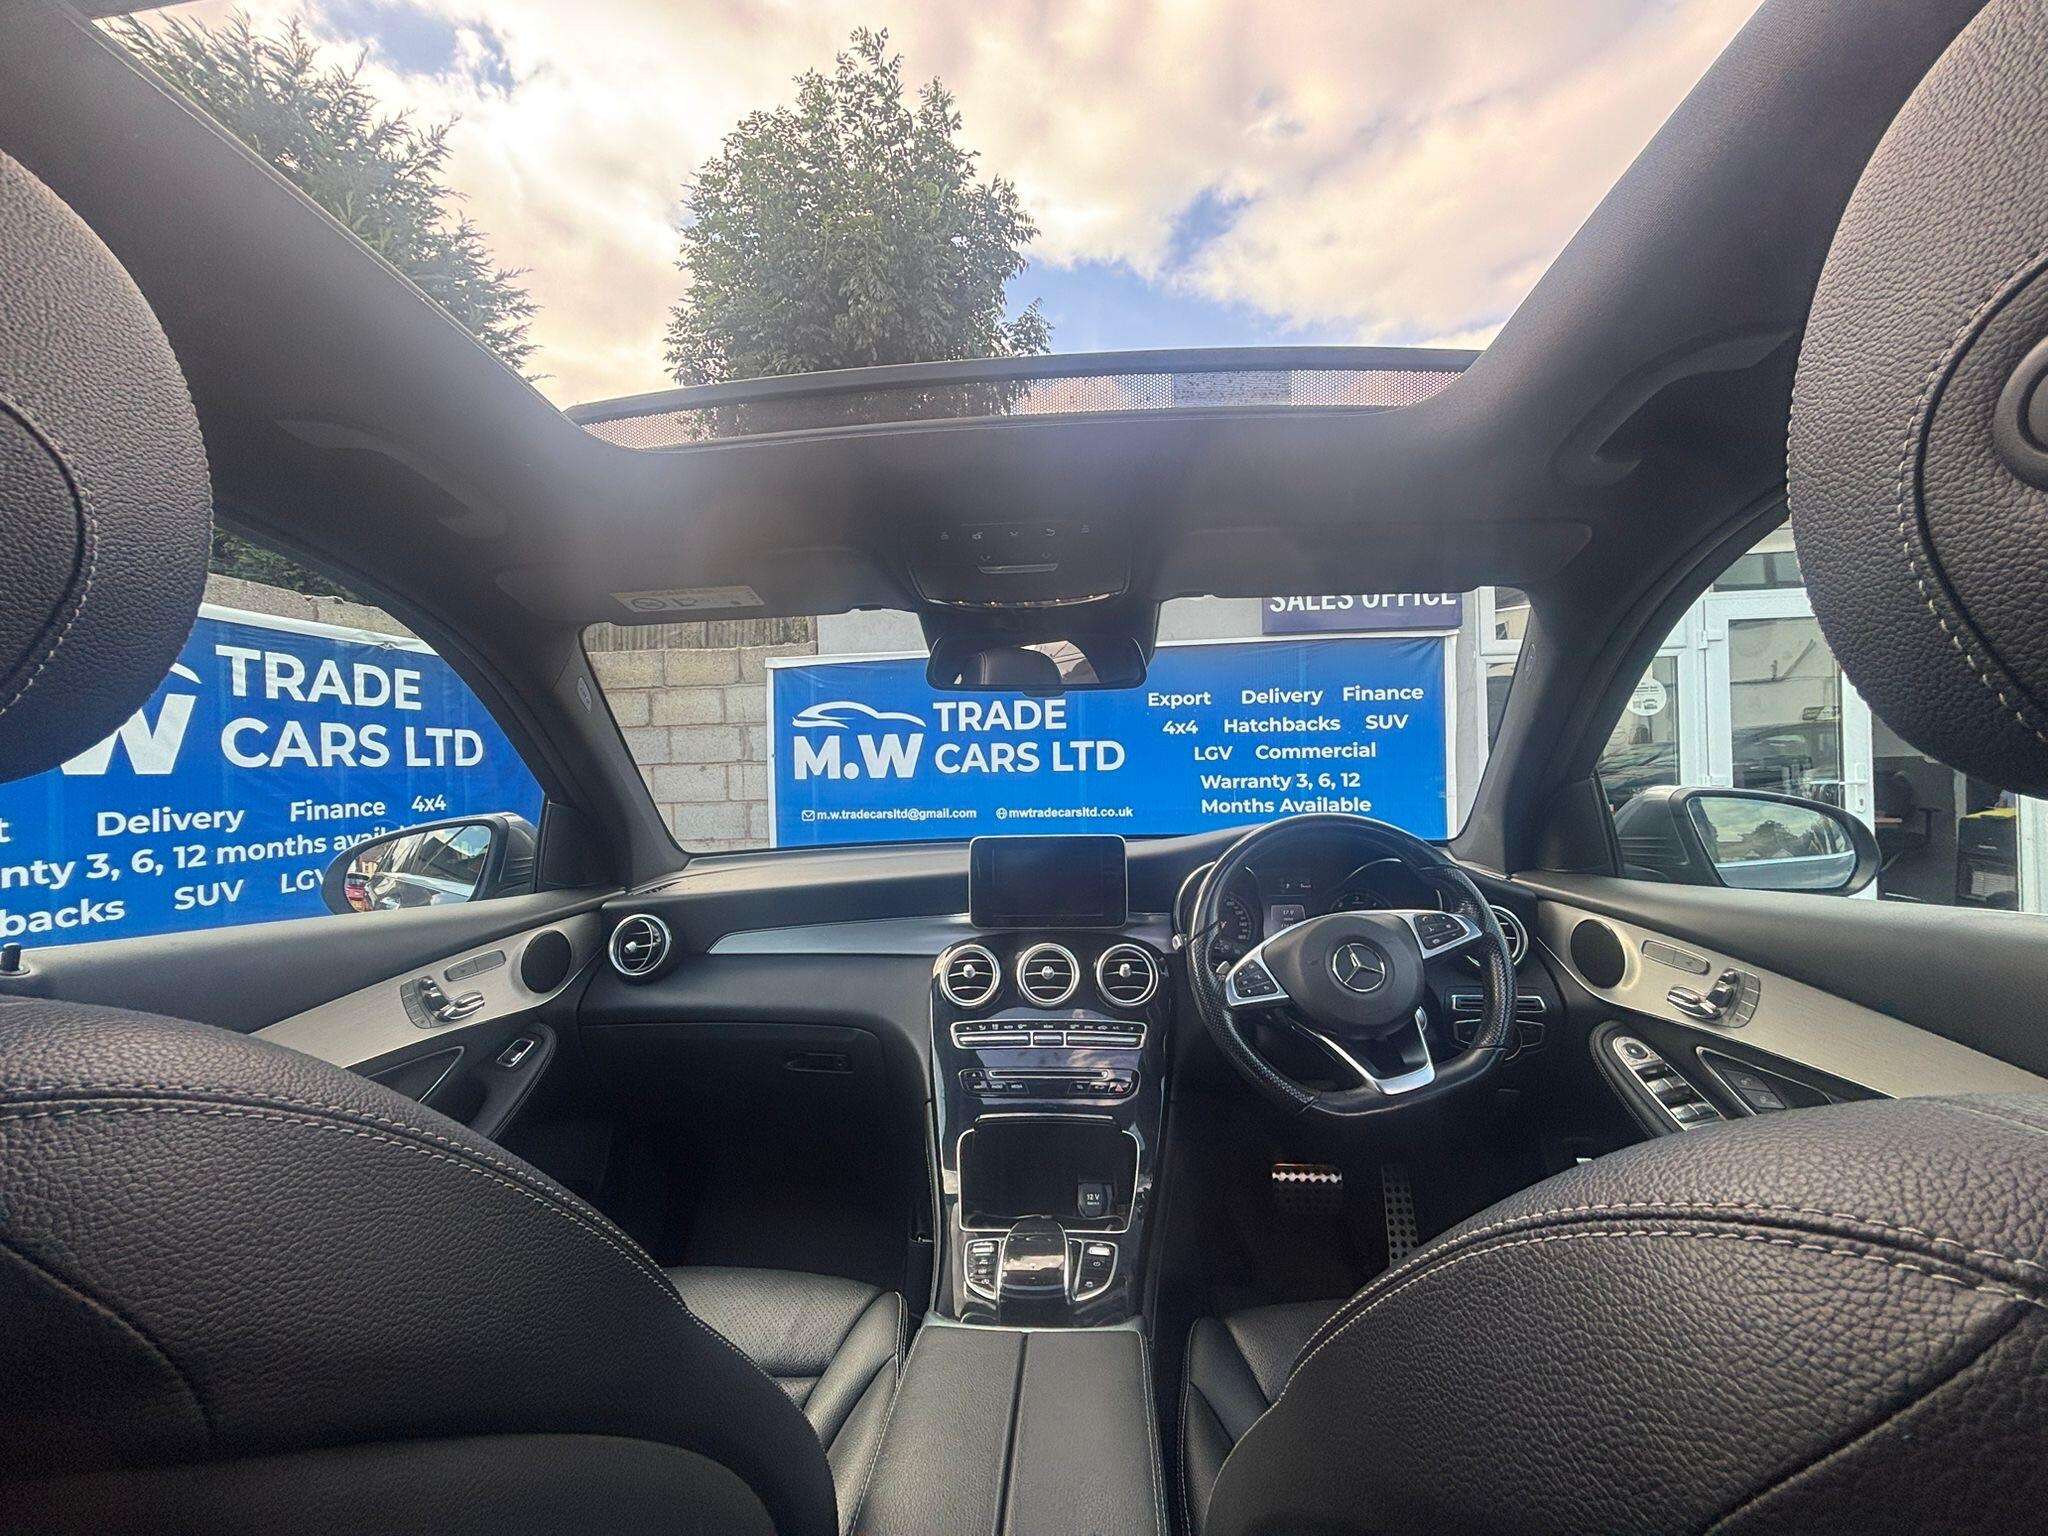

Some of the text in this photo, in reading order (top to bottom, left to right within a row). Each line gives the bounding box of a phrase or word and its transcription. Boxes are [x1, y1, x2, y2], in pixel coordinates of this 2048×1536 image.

[1269, 592, 1456, 612] SALES OFFICE
[215, 645, 422, 711] TRADE
[1149, 684, 1424, 709] Export Delivery Finance
[932, 699, 1067, 732] TRADE
[1162, 714, 1409, 735] 4x4 Hatchbacks SUV
[220, 717, 484, 768] CARS LTD
[793, 733, 924, 780] M.W
[934, 740, 1125, 773] CARS LTD
[1194, 741, 1376, 761] LGV Commercial
[1200, 772, 1361, 792] Warranty 3, 6, 12
[97, 806, 245, 837] Delivery
[290, 799, 386, 822] Finance
[411, 794, 447, 812] 4x4
[817, 808, 977, 821] m.w.tradecarsltd@gmail.com
[1008, 806, 1133, 818] mwtradecarsltd.co.uk
[1201, 795, 1372, 814] Months Available
[86, 853, 121, 881] 3,
[131, 849, 164, 876] 6,
[173, 844, 207, 869] 12
[216, 827, 327, 865] months
[174, 879, 244, 910] SUV
